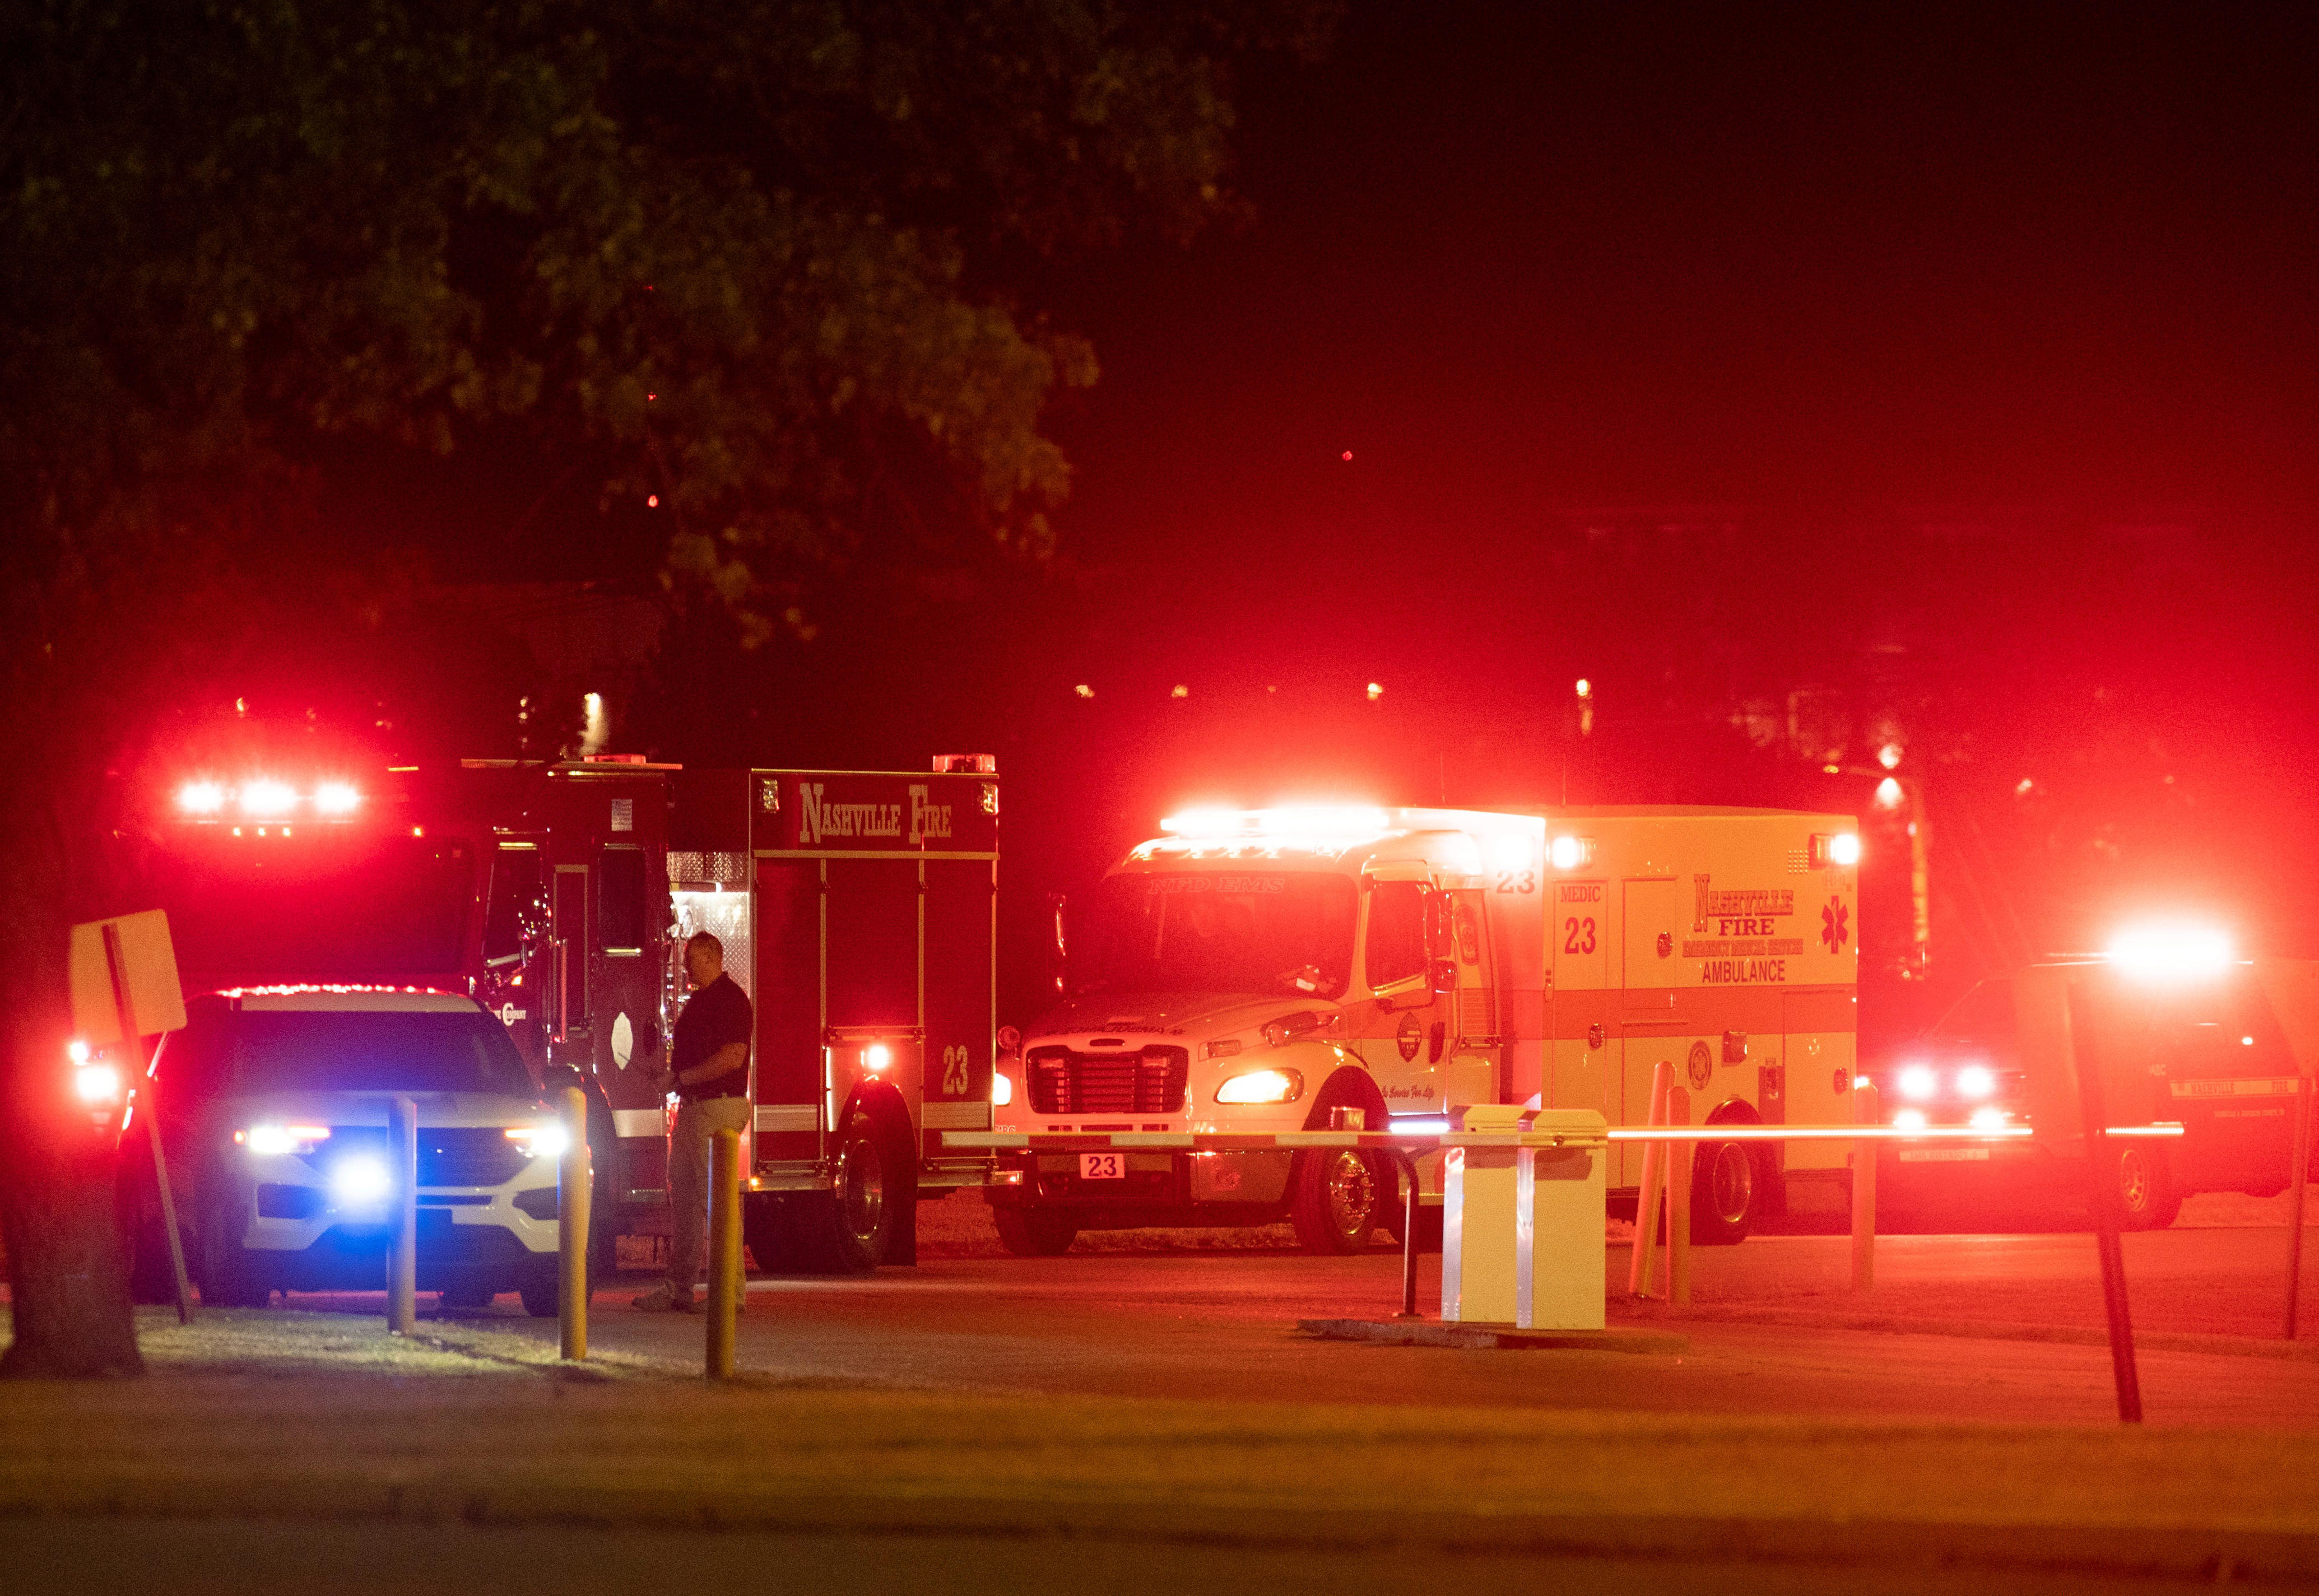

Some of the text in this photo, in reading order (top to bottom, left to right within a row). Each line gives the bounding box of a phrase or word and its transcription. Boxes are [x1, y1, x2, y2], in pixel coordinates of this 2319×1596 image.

[800, 782, 951, 845] NASHVILLE FIRE
[1147, 877, 1286, 895] NFD EMS
[1497, 869, 1535, 895] 23
[1560, 885, 1601, 903] MEDIC
[1693, 873, 1794, 933] NASHVILLE
[1564, 916, 1597, 955] 23
[1718, 918, 1775, 937] FIRE
[1702, 960, 1786, 984] AMBULANCE
[503, 1002, 527, 1026] COMPANY
[942, 1045, 968, 1095] 23
[1089, 1156, 1117, 1177] 23
